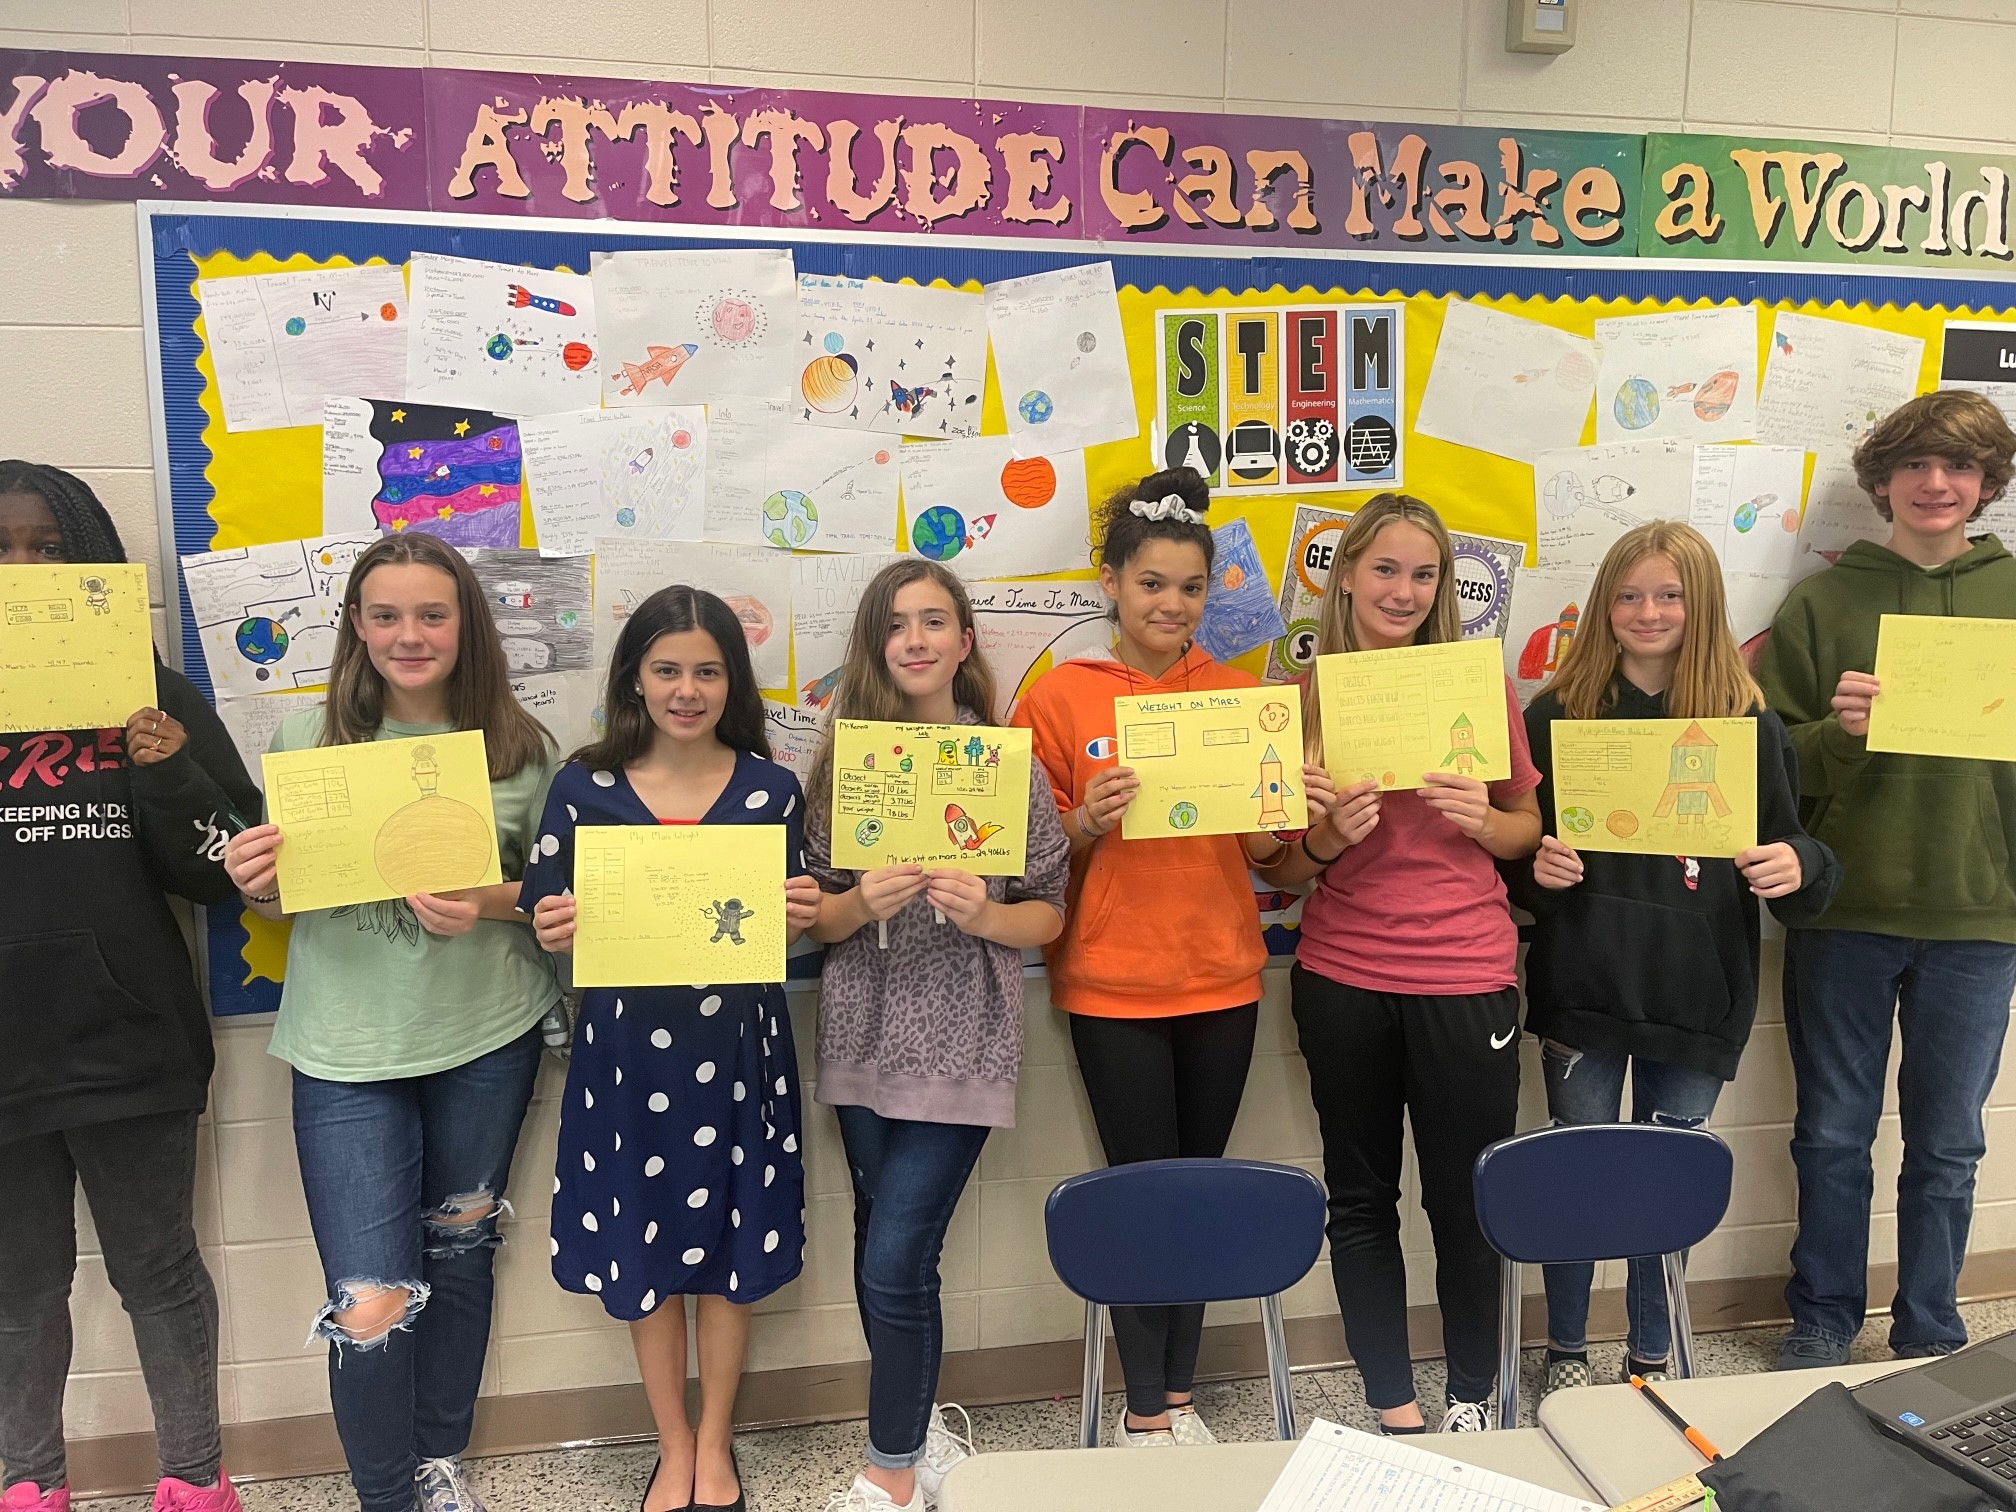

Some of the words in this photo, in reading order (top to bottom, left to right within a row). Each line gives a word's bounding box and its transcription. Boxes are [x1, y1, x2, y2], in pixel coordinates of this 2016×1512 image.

[447, 94, 1071, 229] ATTITUDE
[1100, 123, 1320, 234] Can
[1343, 131, 1624, 248] Make
[1654, 163, 1725, 247] a
[1730, 148, 2012, 259] World
[765, 401, 785, 412] Travel
[1232, 401, 1276, 412] Technology
[1291, 399, 1336, 410] Engineering
[1348, 397, 1394, 406] Mathematics
[718, 408, 732, 419] Info
[1177, 403, 1207, 413] Science
[1305, 544, 1333, 571] GE
[1455, 579, 1493, 602] CCESS
[813, 587, 836, 610] TO
[970, 595, 995, 606] avel
[1006, 588, 1037, 608] Time
[1044, 589, 1066, 609] To
[1070, 592, 1103, 608] Mars
[511, 683, 526, 691] ars
[1343, 675, 1373, 688] OBJECT
[1137, 700, 1182, 712] WEIGHT
[1190, 700, 1204, 709] ON
[1209, 697, 1241, 706] MARS
[763, 706, 786, 720] avel
[791, 708, 817, 725] Time
[840, 721, 869, 730] McKenna
[887, 785, 894, 793] 10
[886, 808, 897, 817] 78
[15, 826, 56, 843] OFF
